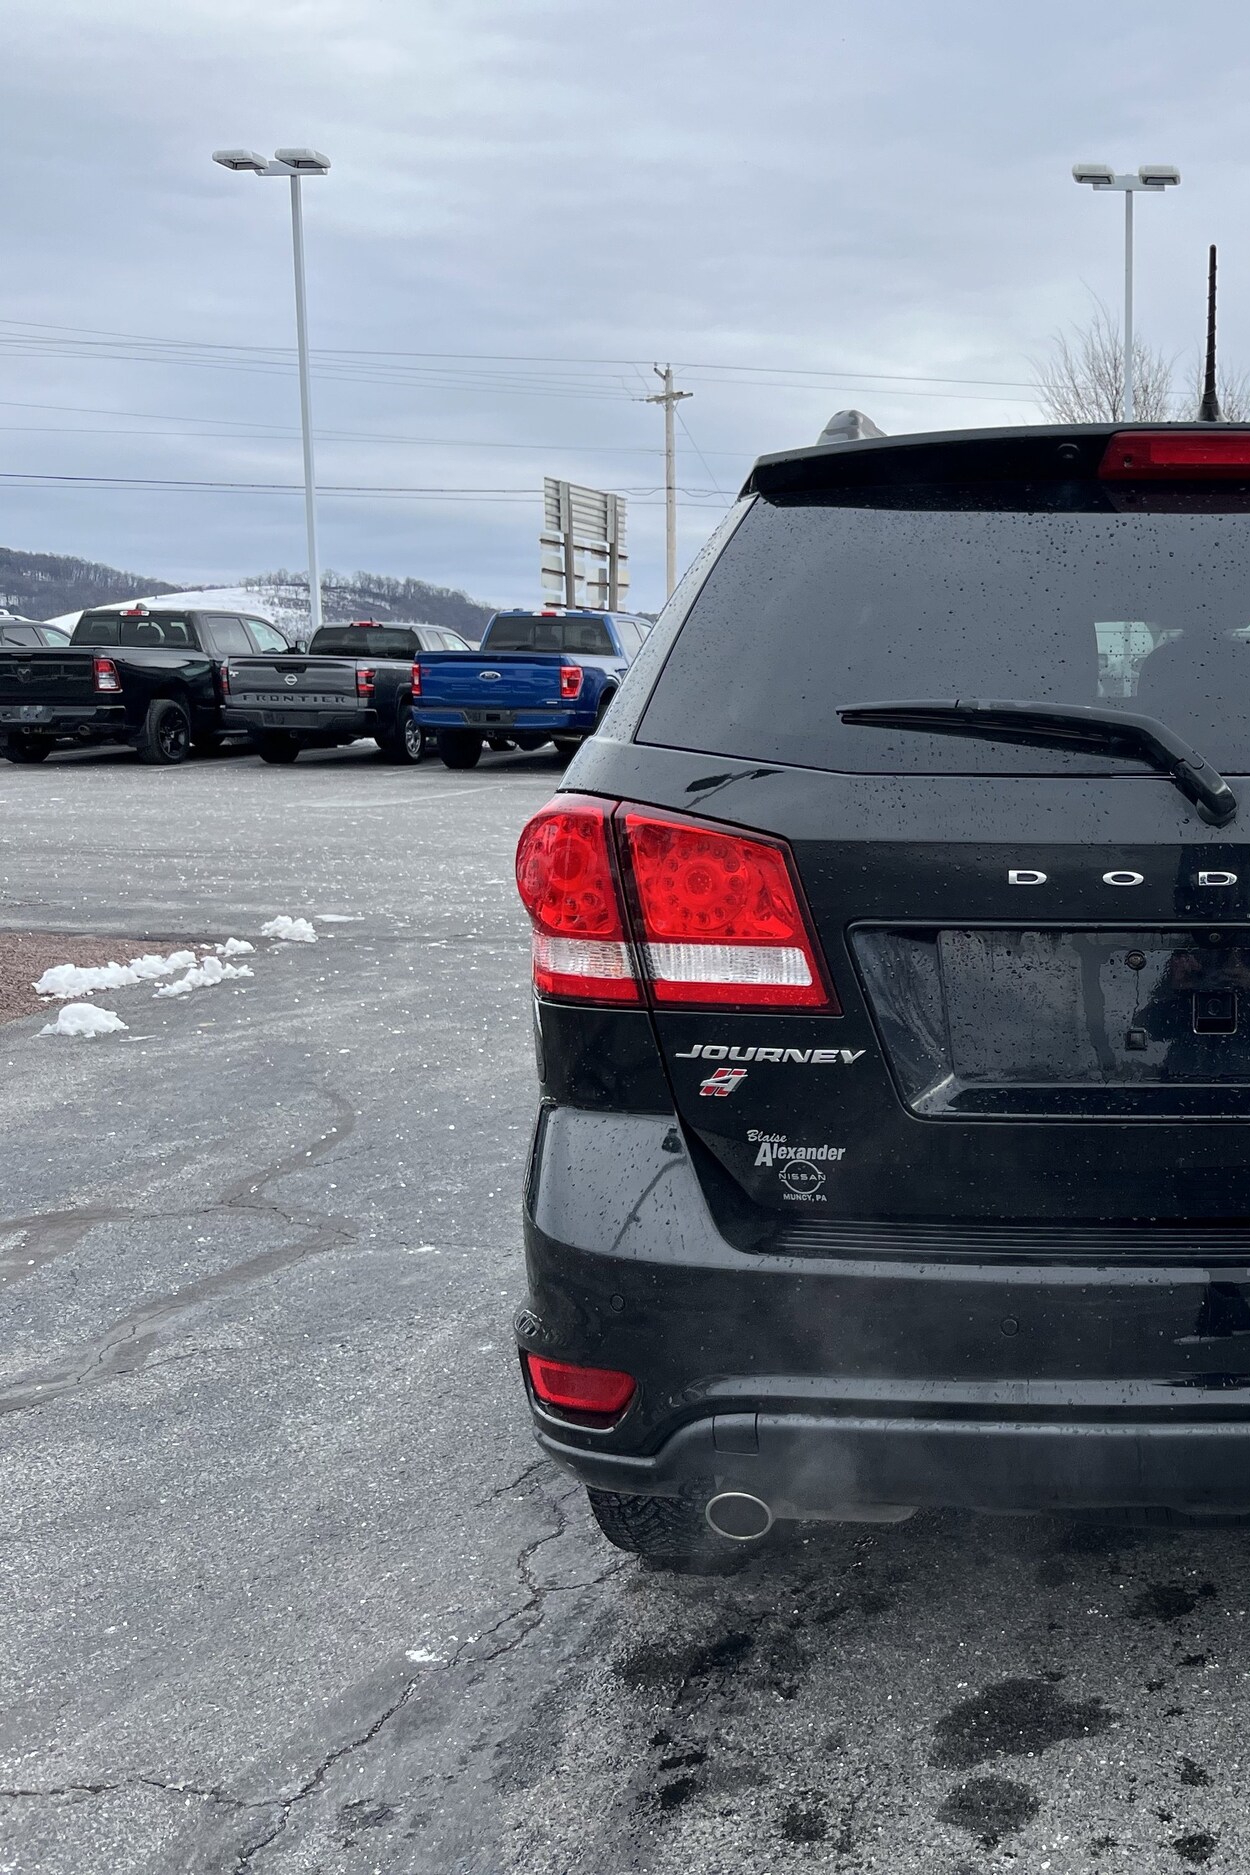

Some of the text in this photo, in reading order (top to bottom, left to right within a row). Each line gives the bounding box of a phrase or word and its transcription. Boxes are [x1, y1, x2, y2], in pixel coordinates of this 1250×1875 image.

[243, 694, 346, 704] FRONTIER
[675, 1044, 867, 1064] JOURNEY
[746, 1129, 788, 1143] Blaise
[753, 1142, 846, 1167] Alexander
[778, 1172, 826, 1181] NISSAN
[783, 1193, 828, 1202] MUNCY, PA
